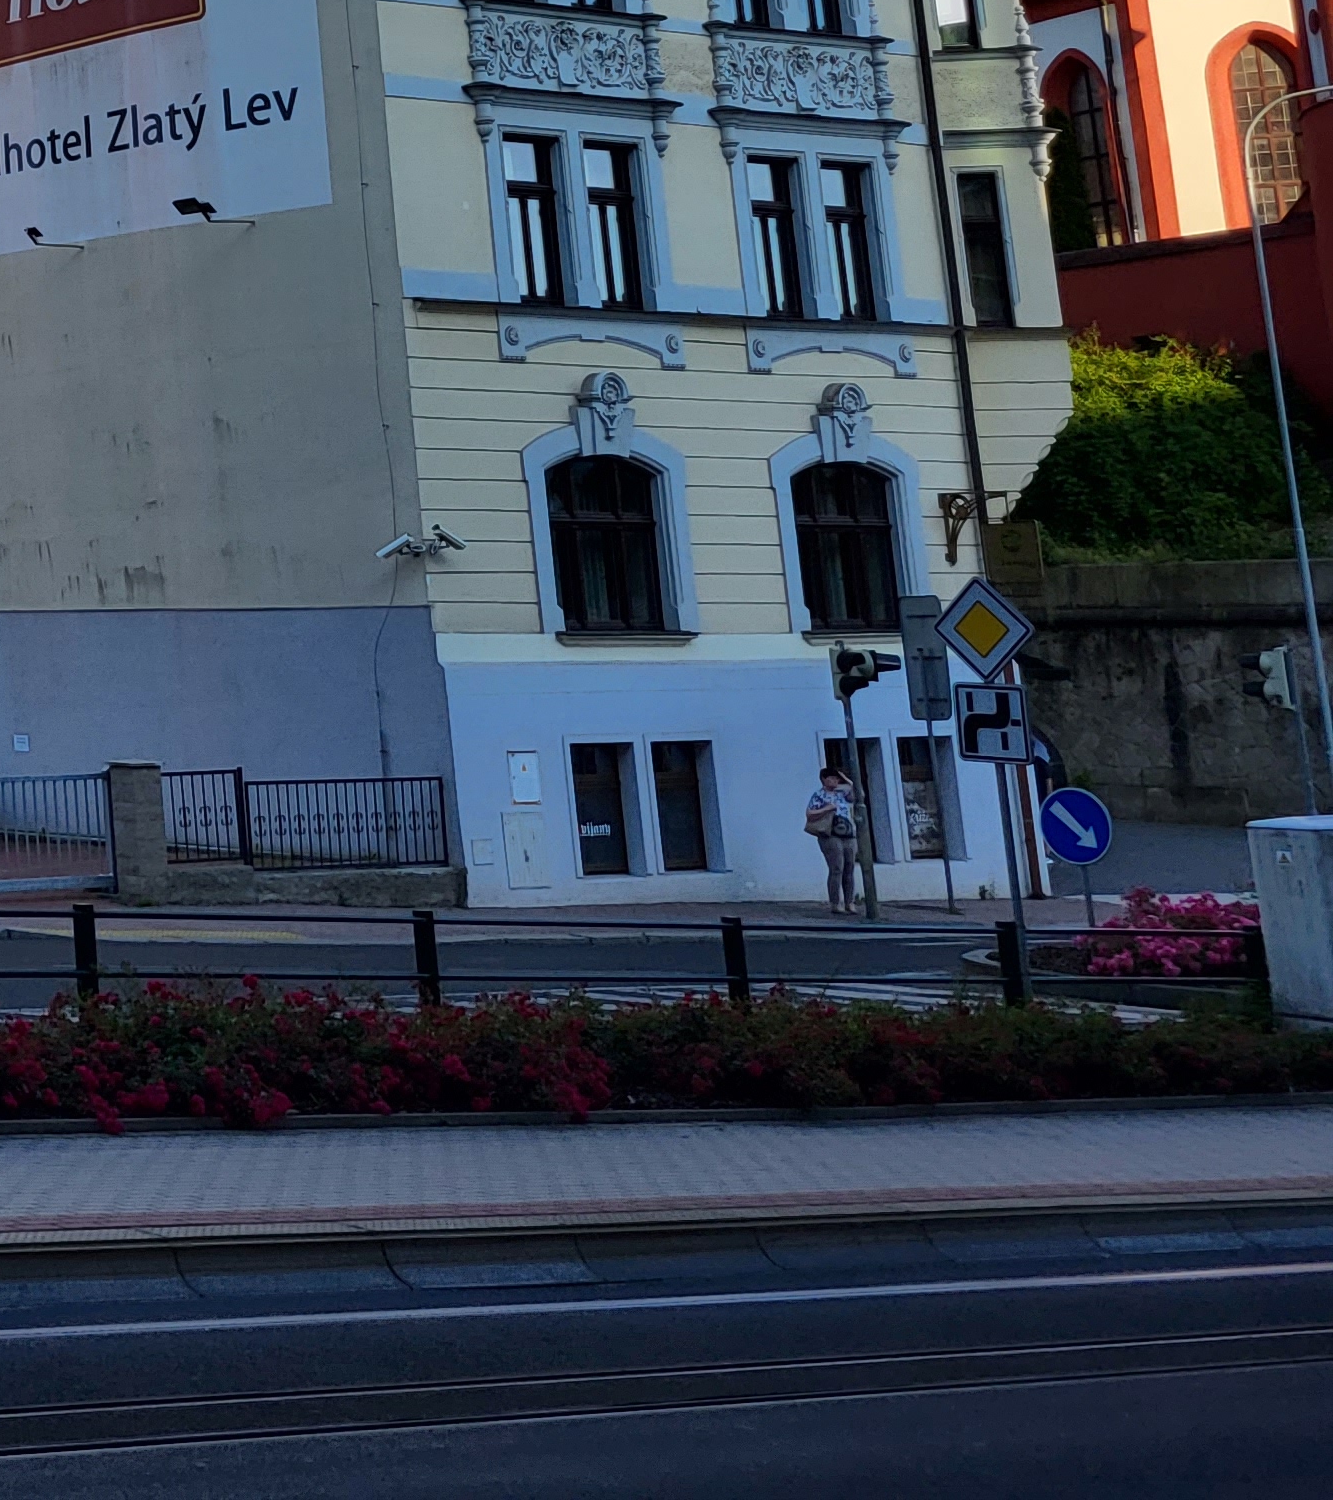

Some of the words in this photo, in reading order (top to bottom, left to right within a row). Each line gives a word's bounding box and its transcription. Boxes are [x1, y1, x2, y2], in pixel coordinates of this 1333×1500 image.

[107, 91, 207, 154] Zlatý
[223, 85, 299, 132] Lev
[579, 821, 611, 837] vijany
